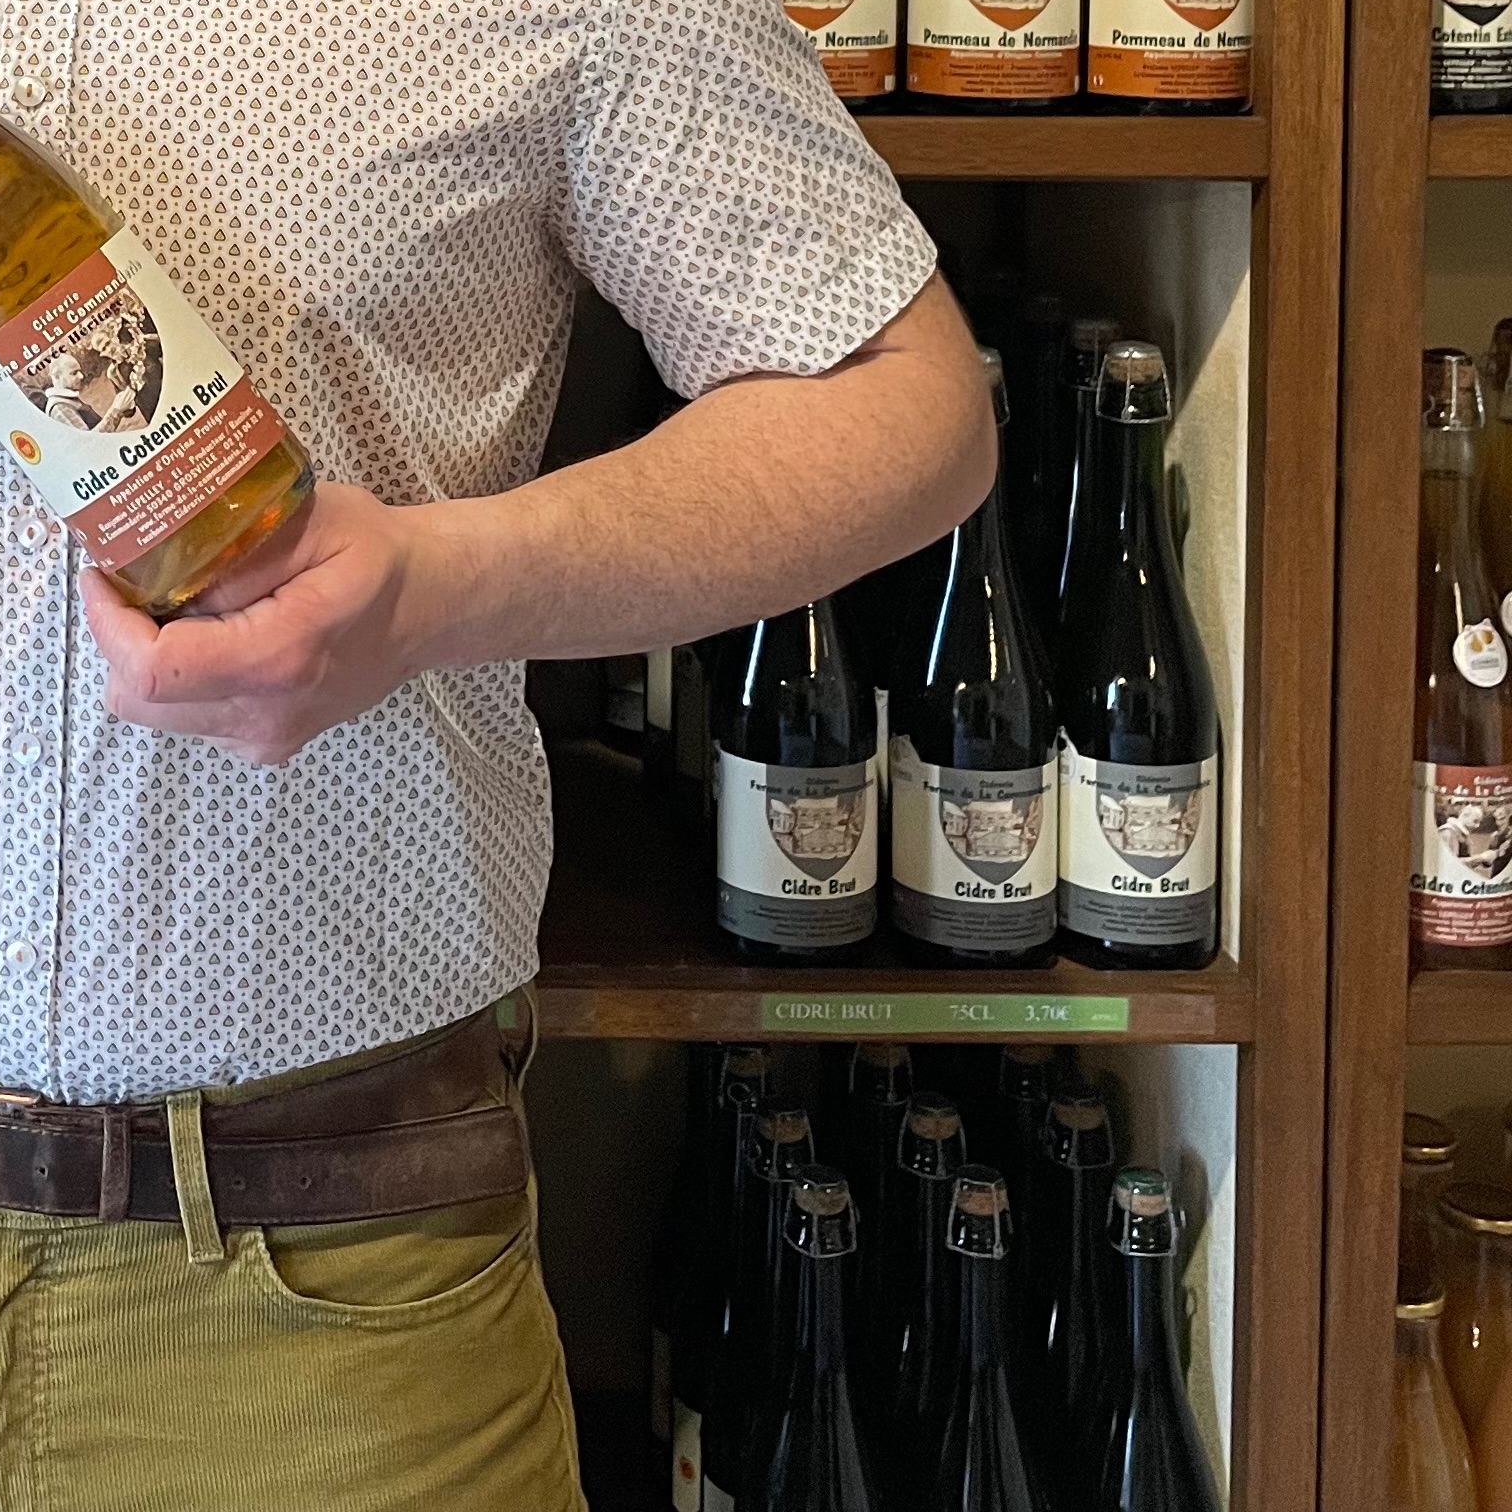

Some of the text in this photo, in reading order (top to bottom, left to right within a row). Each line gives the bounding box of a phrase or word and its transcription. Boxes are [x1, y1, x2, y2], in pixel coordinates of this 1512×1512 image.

[825, 30, 888, 48] Normandi
[924, 28, 990, 48] Pommeau
[998, 31, 1016, 47] de
[1112, 29, 1210, 48] Pommeau de
[32, 292, 80, 331] Cidrerie
[22, 343, 41, 360] de
[42, 326, 64, 343] La
[27, 296, 125, 377] Cuvée Héritage
[72, 370, 229, 501] Cidre Cotentin Brut
[146, 489, 174, 513] 50340
[173, 452, 219, 492] GROSVILLE
[126, 480, 165, 513] LEPELLEY
[782, 878, 856, 896] Cidre Brut
[955, 881, 1032, 898] Cidre Brut
[1111, 875, 1190, 893] Cidre Brut
[1410, 873, 1453, 893] Cidre
[775, 1003, 835, 1020] CIDRE
[841, 1003, 892, 1020] BRUT
[949, 1004, 993, 1021] 75CL
[1025, 1004, 1071, 1022] 3,70€
